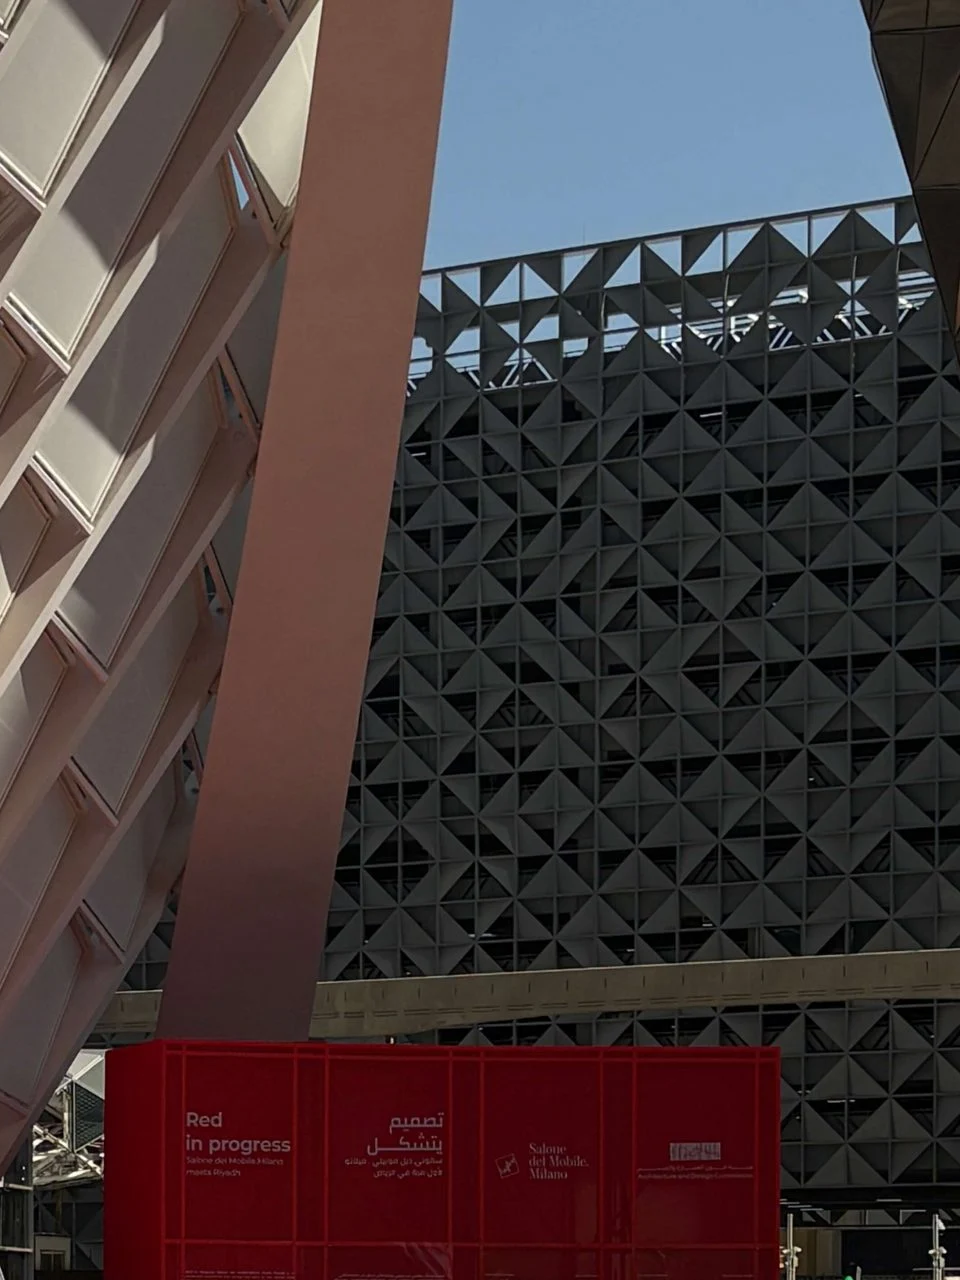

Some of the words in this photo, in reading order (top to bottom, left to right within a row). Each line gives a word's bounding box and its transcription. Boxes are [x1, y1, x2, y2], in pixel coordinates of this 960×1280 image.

[186, 1112, 223, 1128] Red
[389, 1112, 445, 1135] تصميم
[186, 1134, 202, 1151] in
[209, 1139, 291, 1155] progress
[528, 1142, 567, 1154] Salone
[528, 1155, 546, 1167] del
[529, 1167, 568, 1180] Milano
